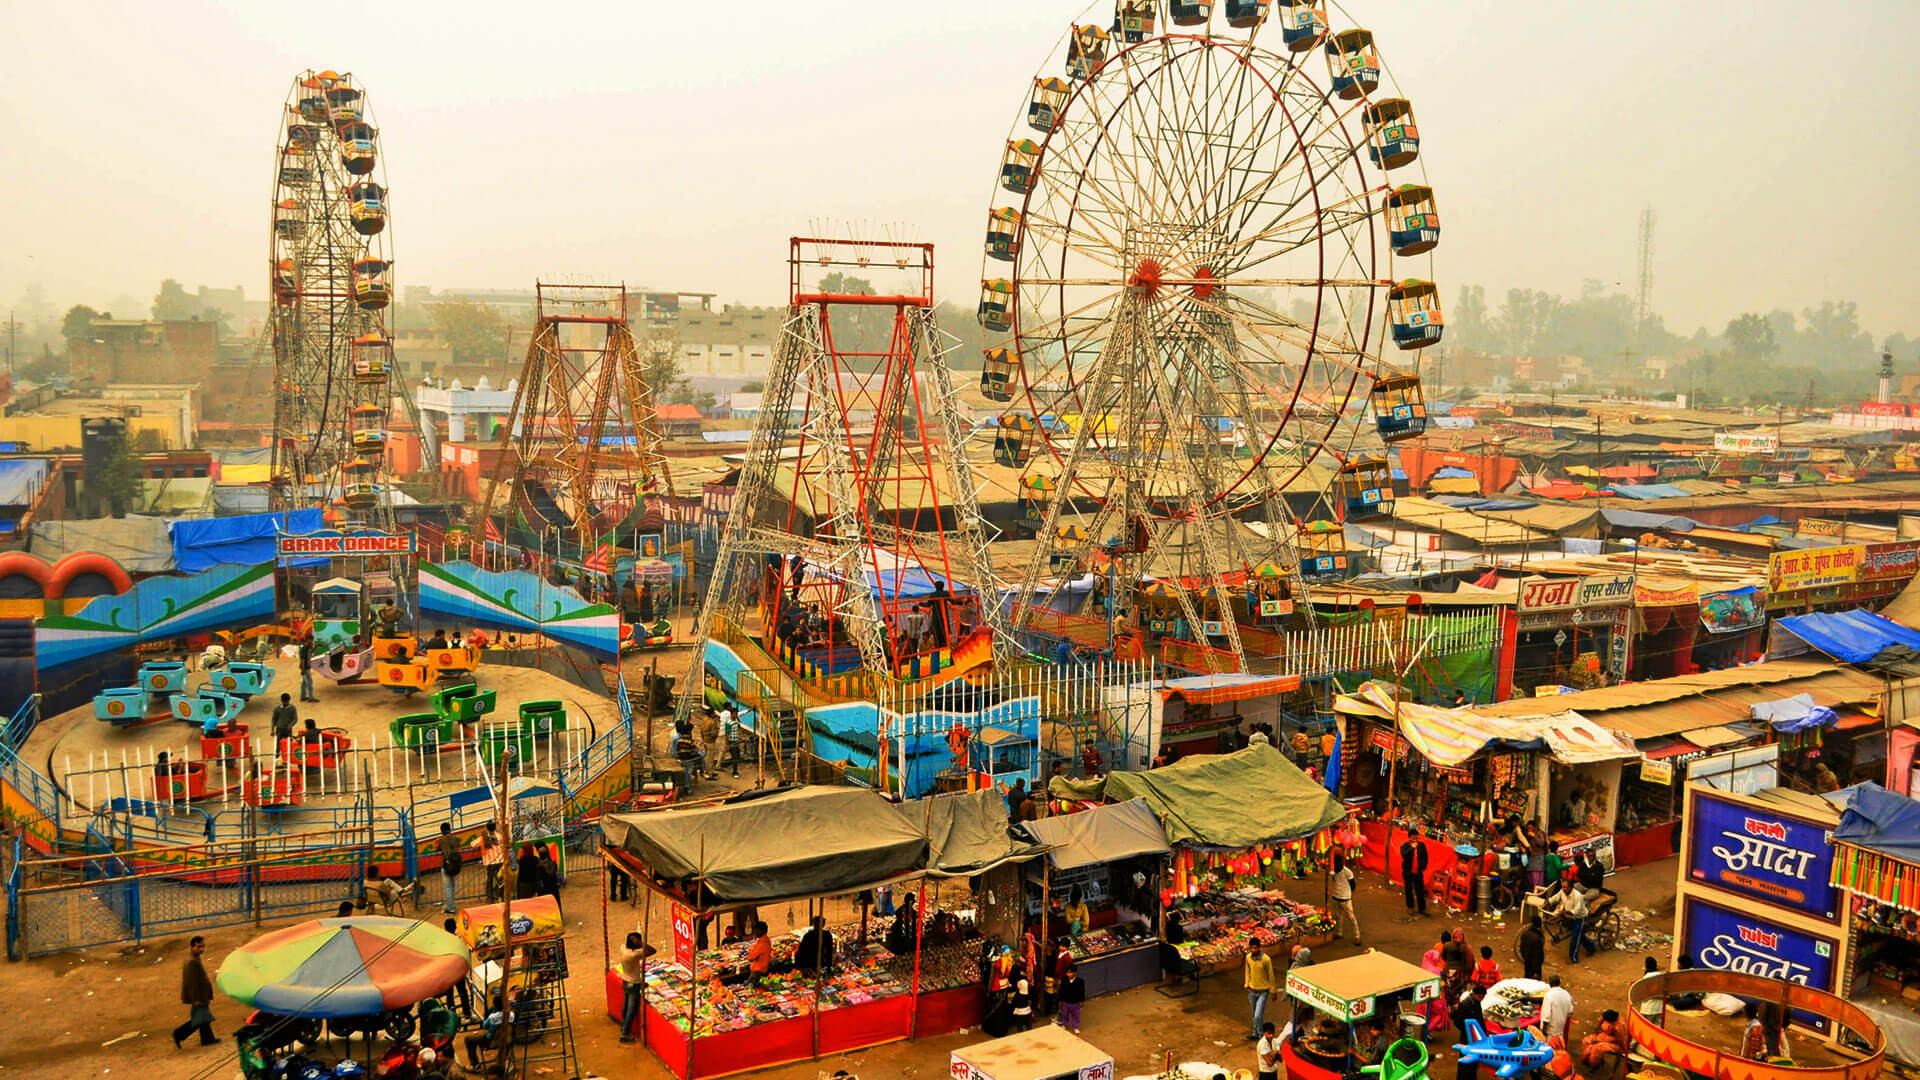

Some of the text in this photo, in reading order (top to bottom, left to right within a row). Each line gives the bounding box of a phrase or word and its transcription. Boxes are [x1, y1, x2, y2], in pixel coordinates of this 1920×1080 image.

[282, 535, 411, 552] BRAK DANCE
[1523, 580, 1578, 607] राजा
[1583, 583, 1604, 603] सुपर
[1712, 831, 1817, 880] सादा
[675, 919, 689, 939] 40
[1287, 976, 1310, 995] संजय
